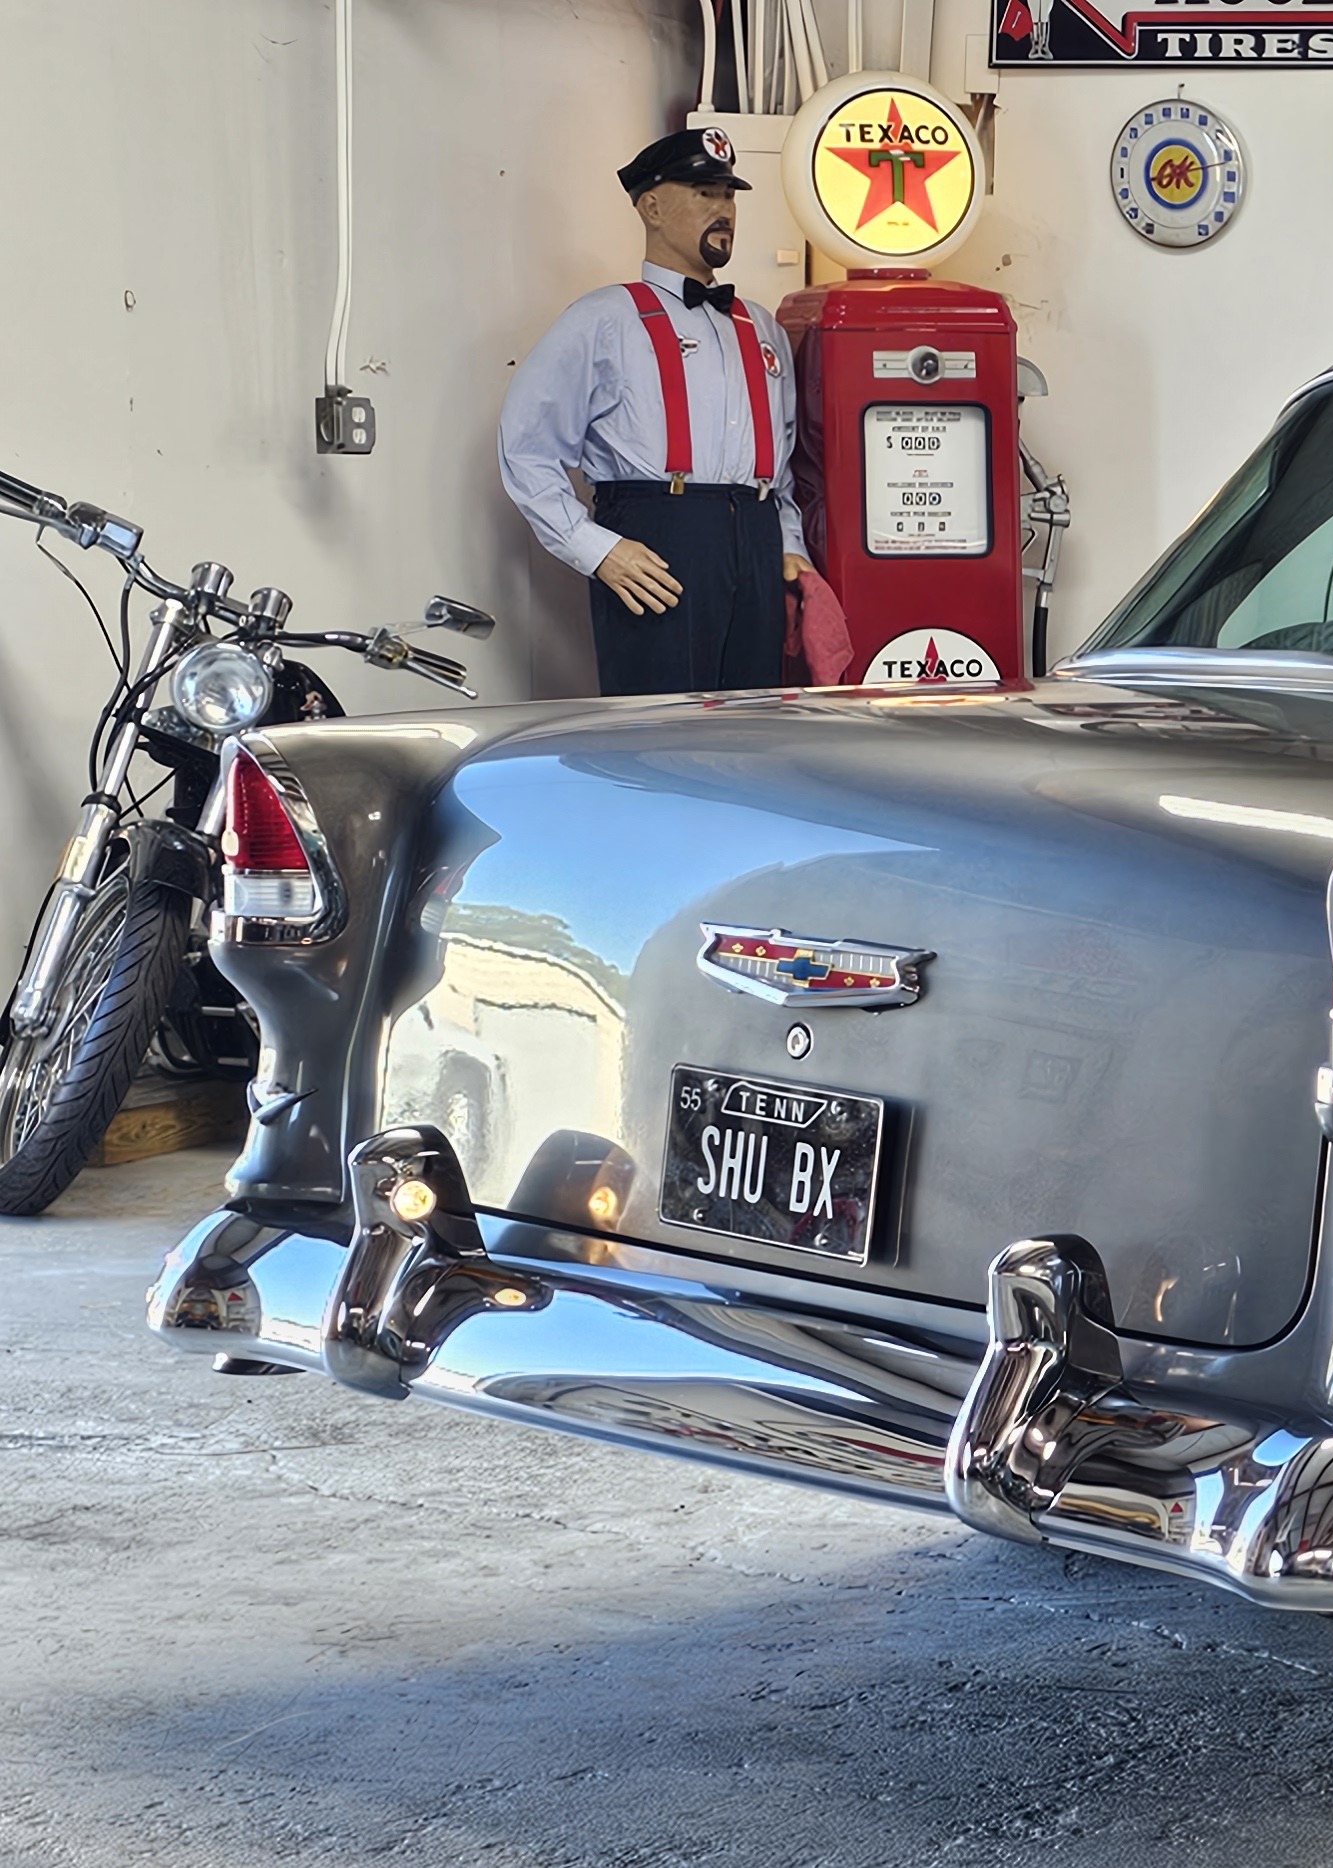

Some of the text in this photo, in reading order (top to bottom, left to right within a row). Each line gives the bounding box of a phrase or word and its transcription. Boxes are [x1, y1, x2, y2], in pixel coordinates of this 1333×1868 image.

[839, 123, 949, 145] TEXACO
[1151, 155, 1195, 189] OK
[883, 658, 983, 679] TEXACO
[680, 1087, 805, 1122] 55 TENN
[697, 1125, 840, 1219] SHU BX
